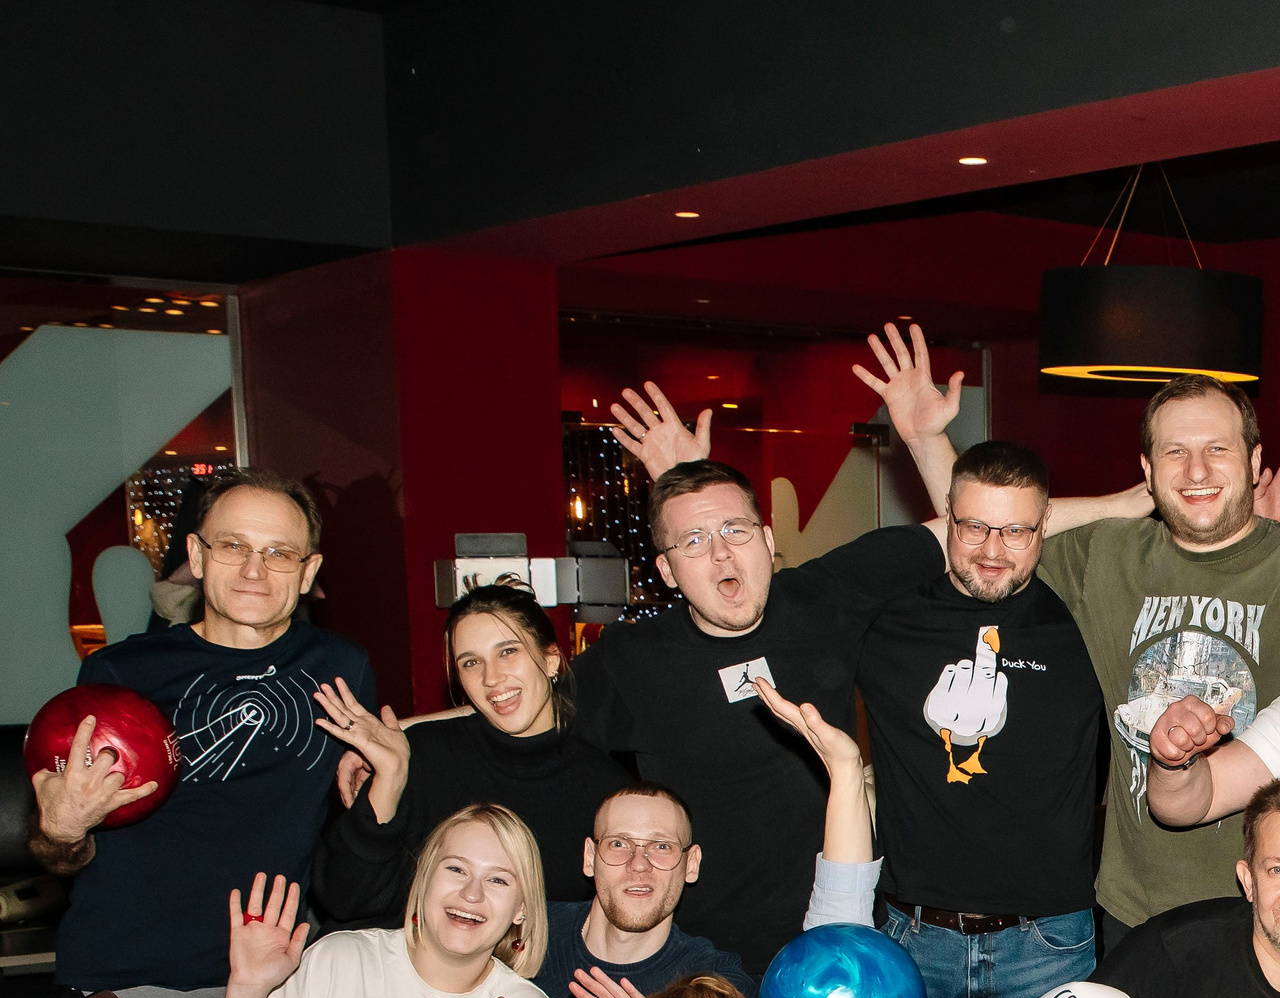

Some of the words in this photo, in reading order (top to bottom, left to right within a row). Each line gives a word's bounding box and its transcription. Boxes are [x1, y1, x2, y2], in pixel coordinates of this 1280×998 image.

[1128, 595, 1188, 658] NEW
[1188, 594, 1267, 667] YORK
[1001, 657, 1027, 669] Duck
[1026, 660, 1047, 671] You
